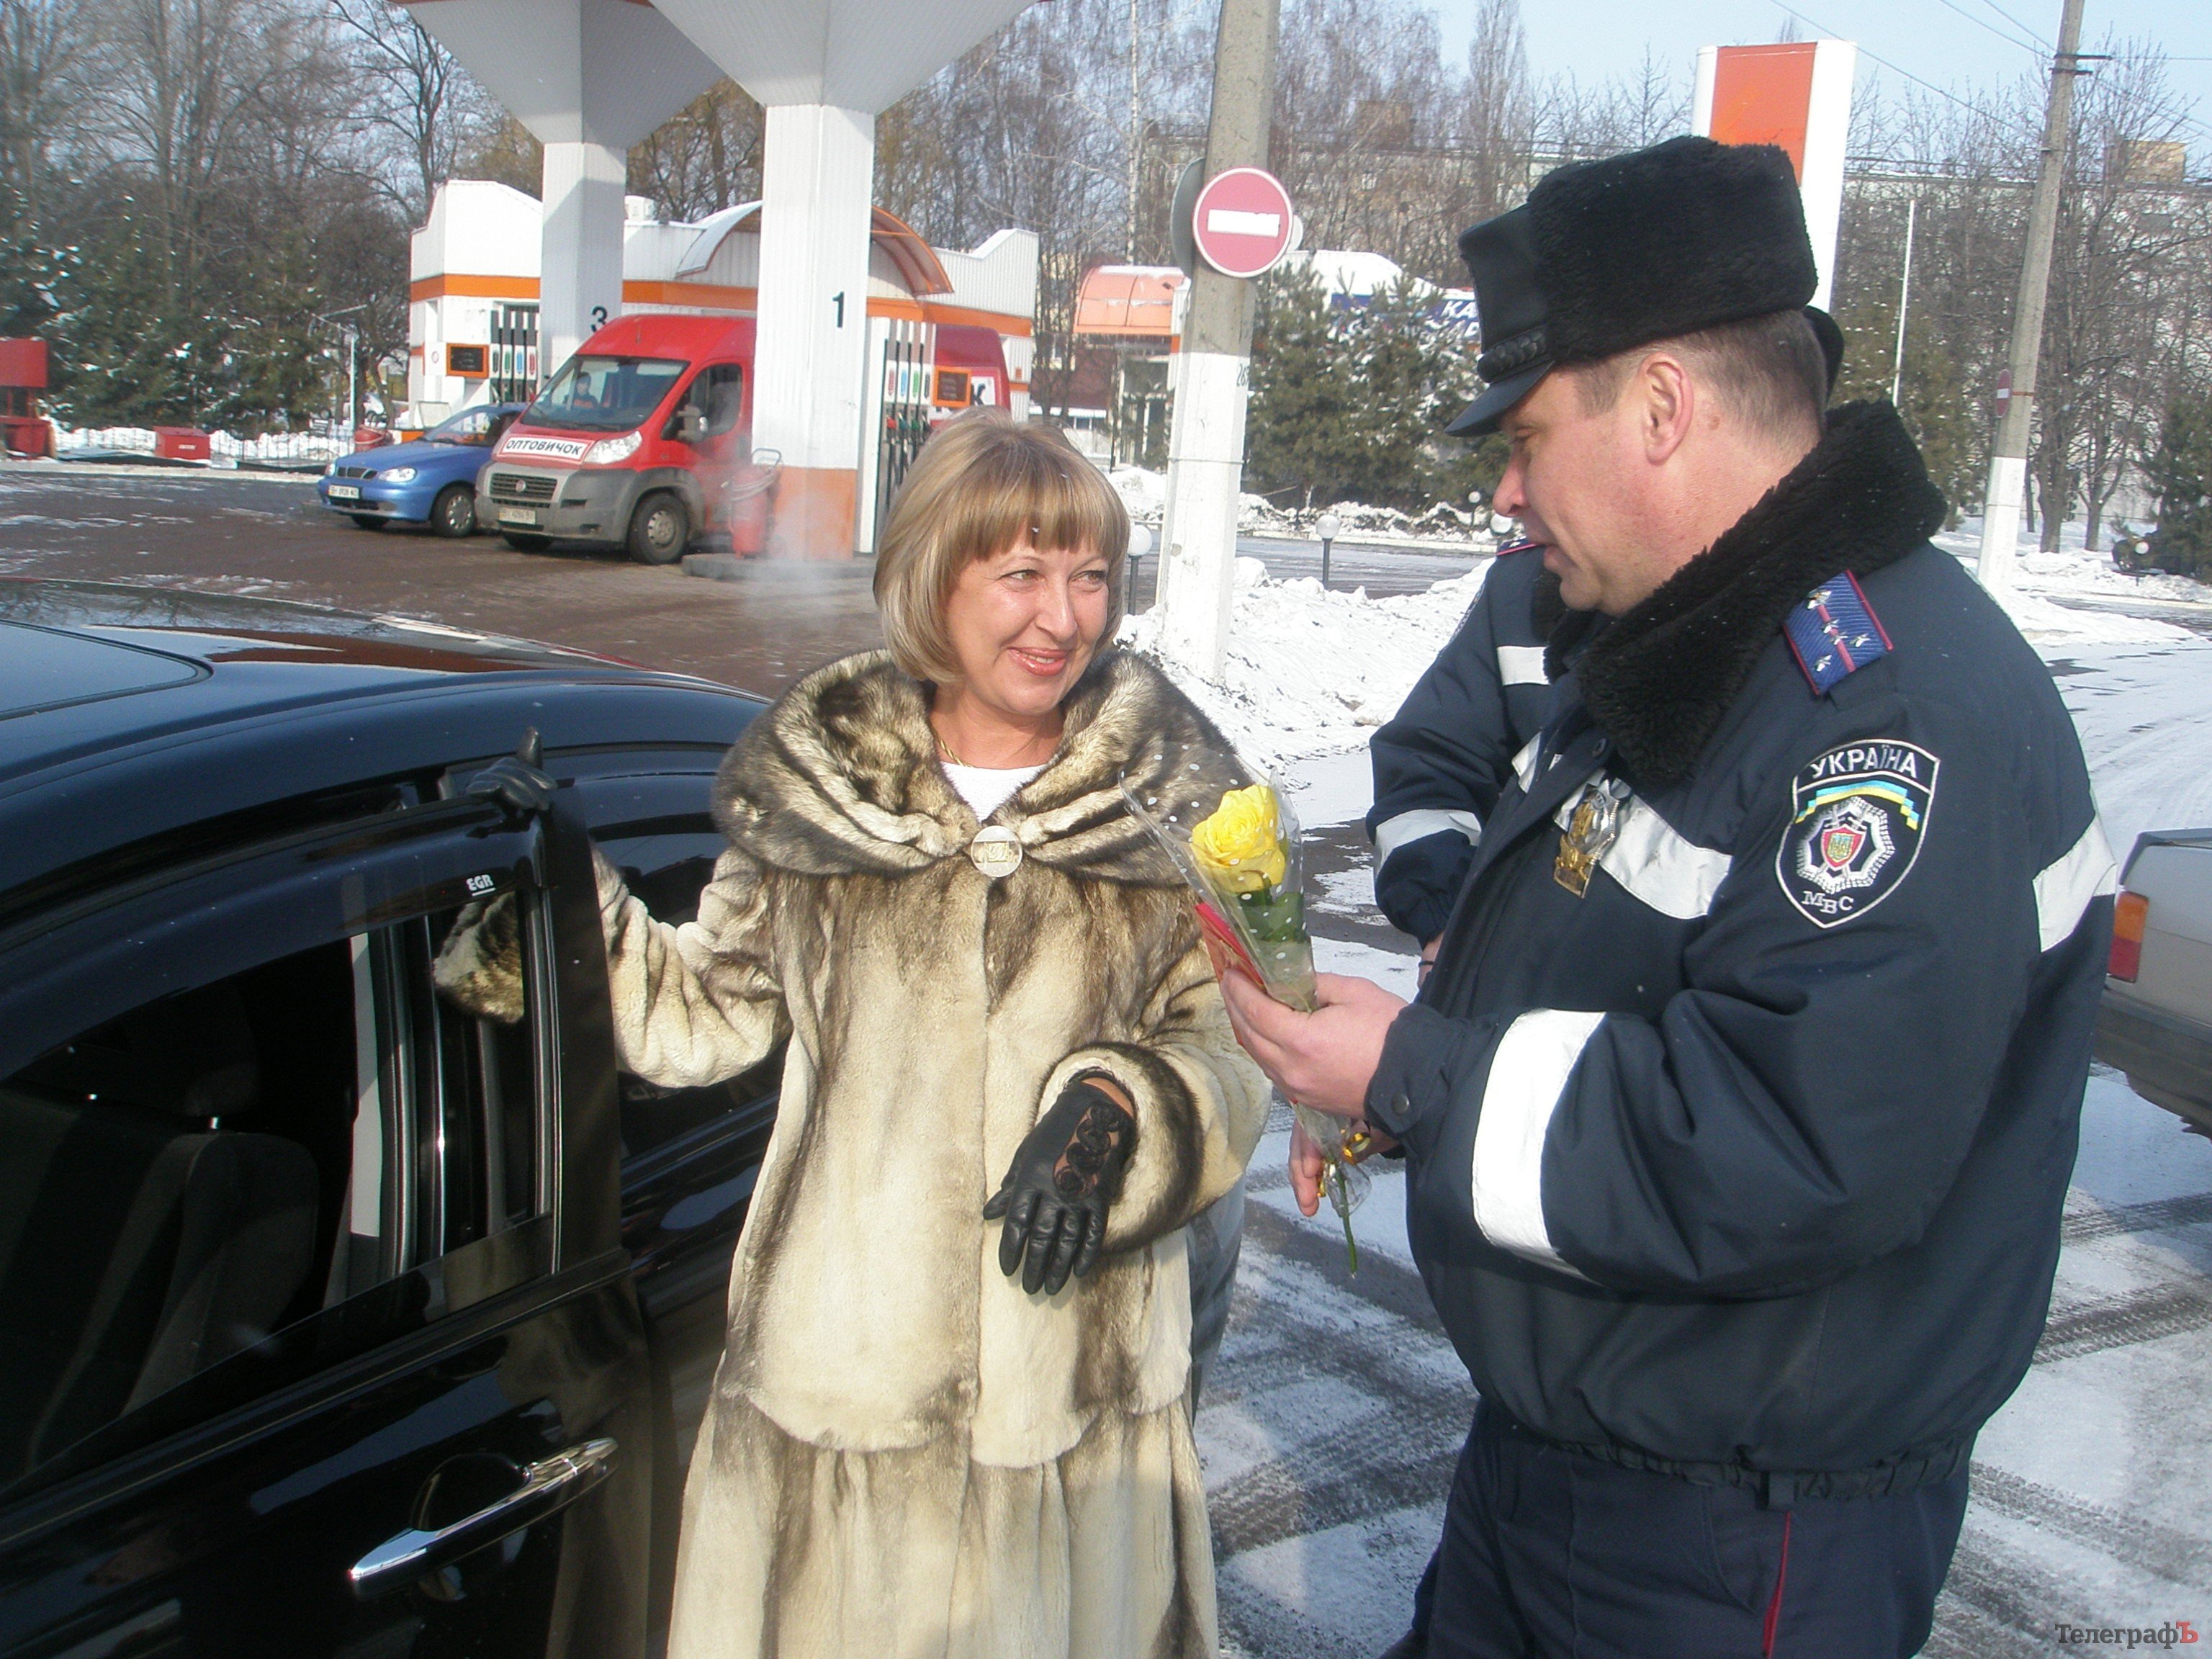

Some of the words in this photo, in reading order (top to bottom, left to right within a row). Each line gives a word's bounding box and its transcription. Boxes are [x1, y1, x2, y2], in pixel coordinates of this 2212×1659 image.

[590, 305, 608, 333] 3
[832, 291, 845, 328] 1
[505, 440, 583, 455] ОПТОВИЧОК
[1809, 744, 1917, 778] УКРАЇНА
[466, 874, 494, 891] EGR
[1801, 890, 1854, 914] МВС
